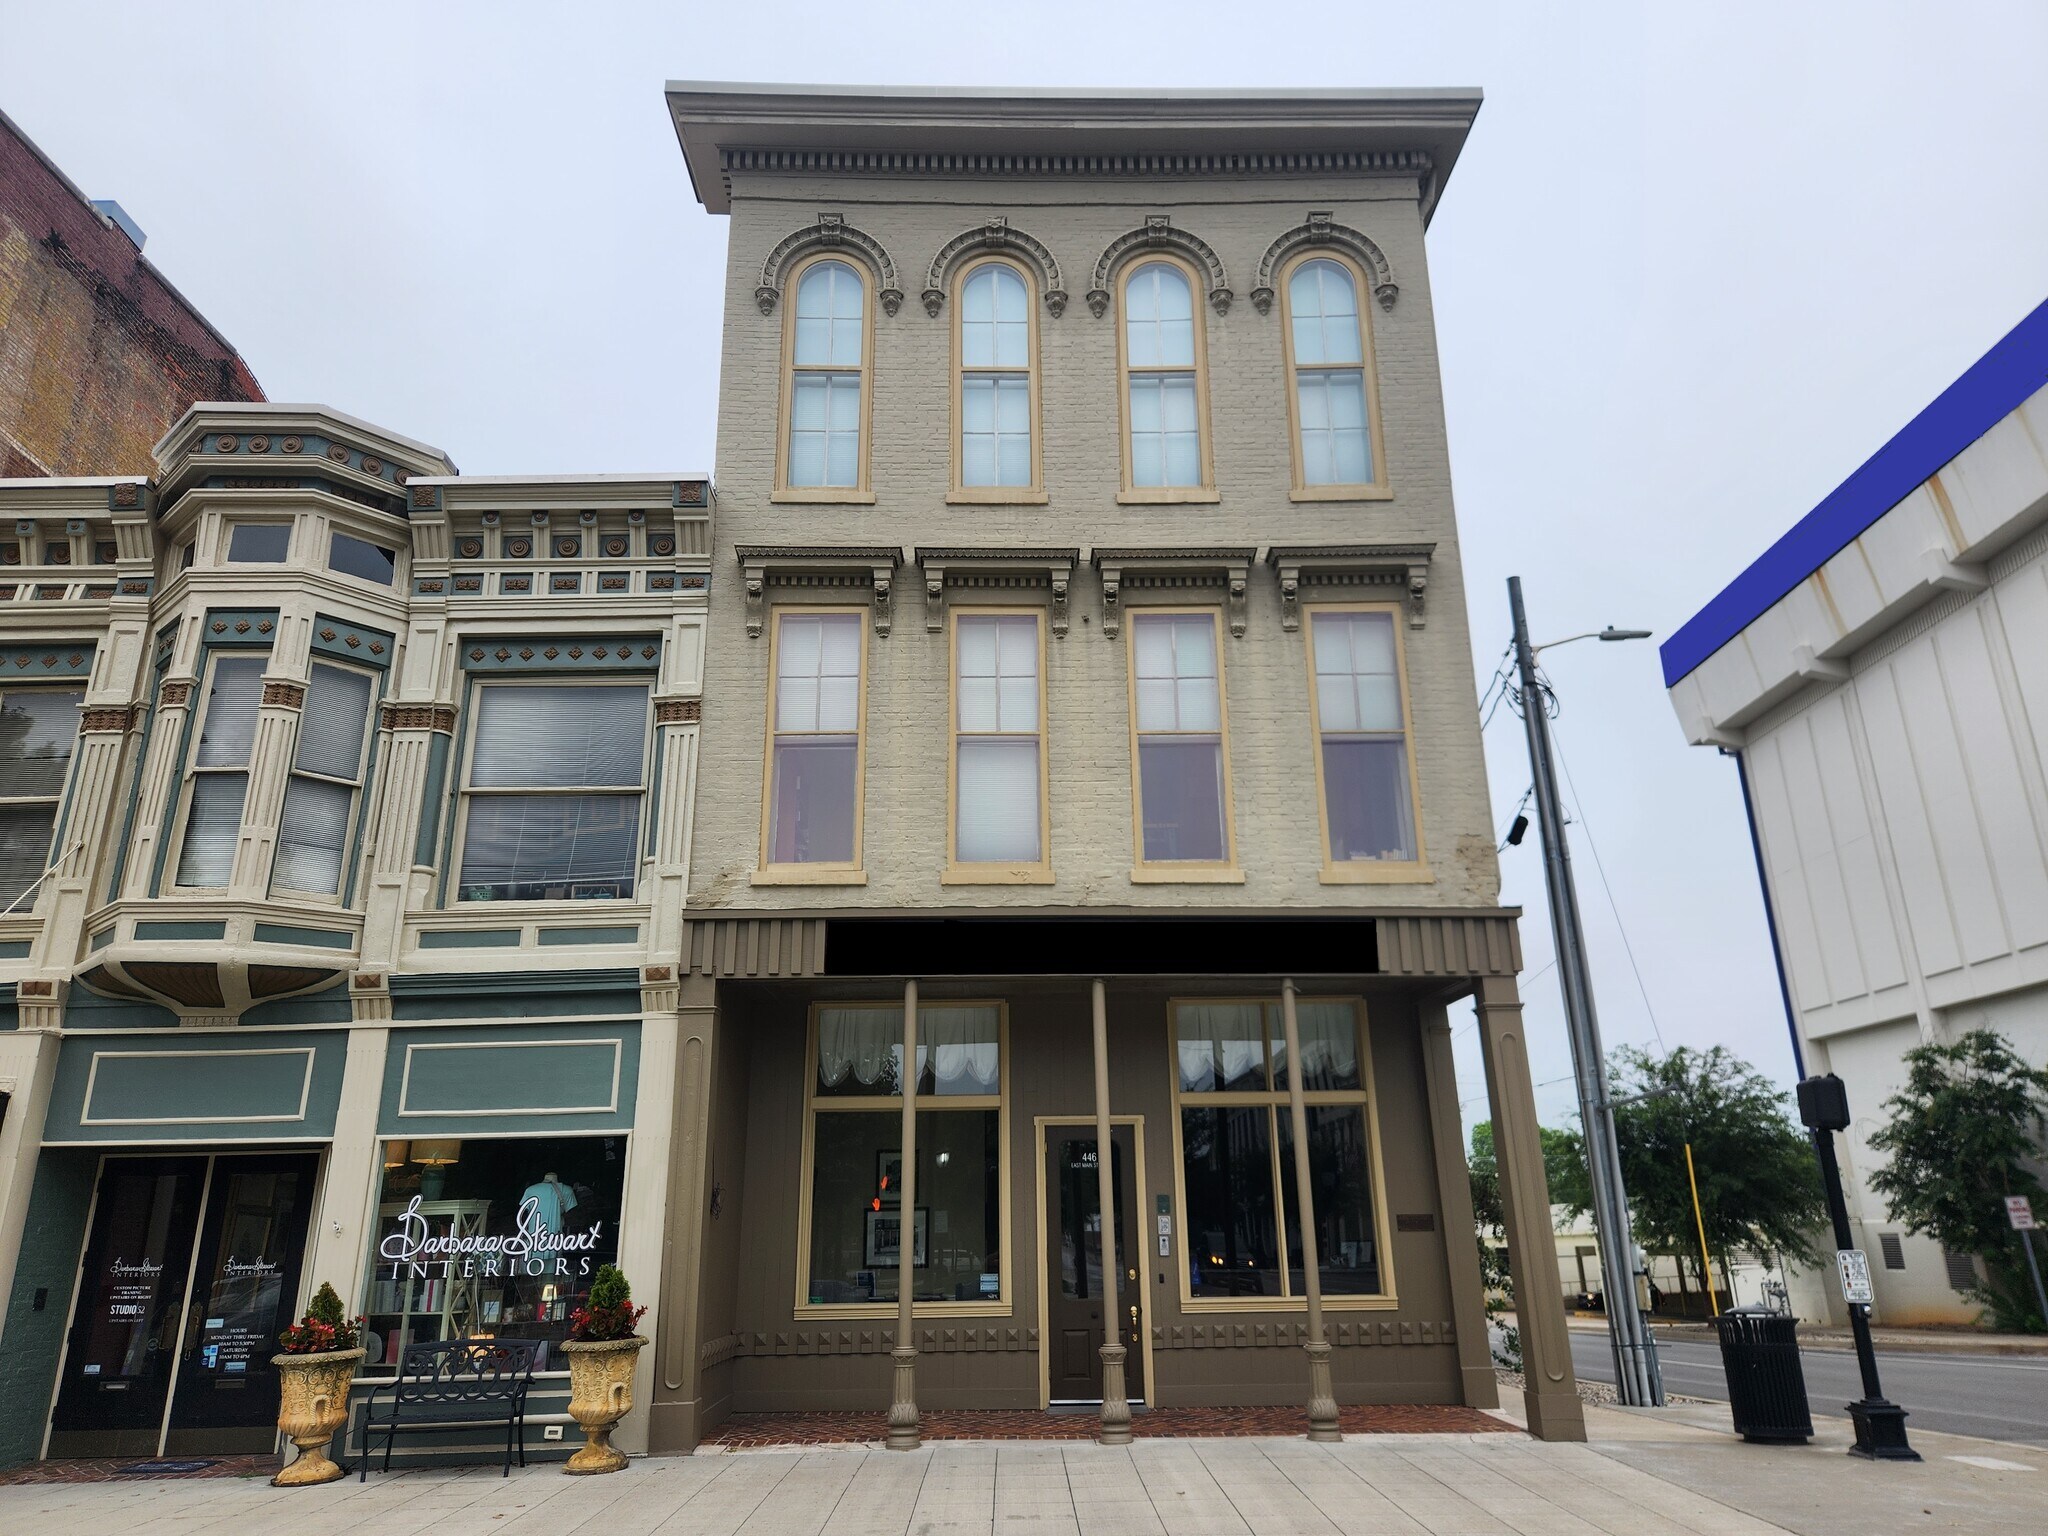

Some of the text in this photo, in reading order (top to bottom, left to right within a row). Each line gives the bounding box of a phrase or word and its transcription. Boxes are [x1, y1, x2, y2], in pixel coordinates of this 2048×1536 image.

[1082, 1152, 1097, 1162] 446
[380, 1194, 602, 1262] Barbara Stewart
[110, 1256, 164, 1273] Barbara Stewart
[223, 1255, 277, 1272] Barbara Stewart
[392, 1257, 590, 1280] INTERIORS
[110, 1304, 137, 1315] STUDIO
